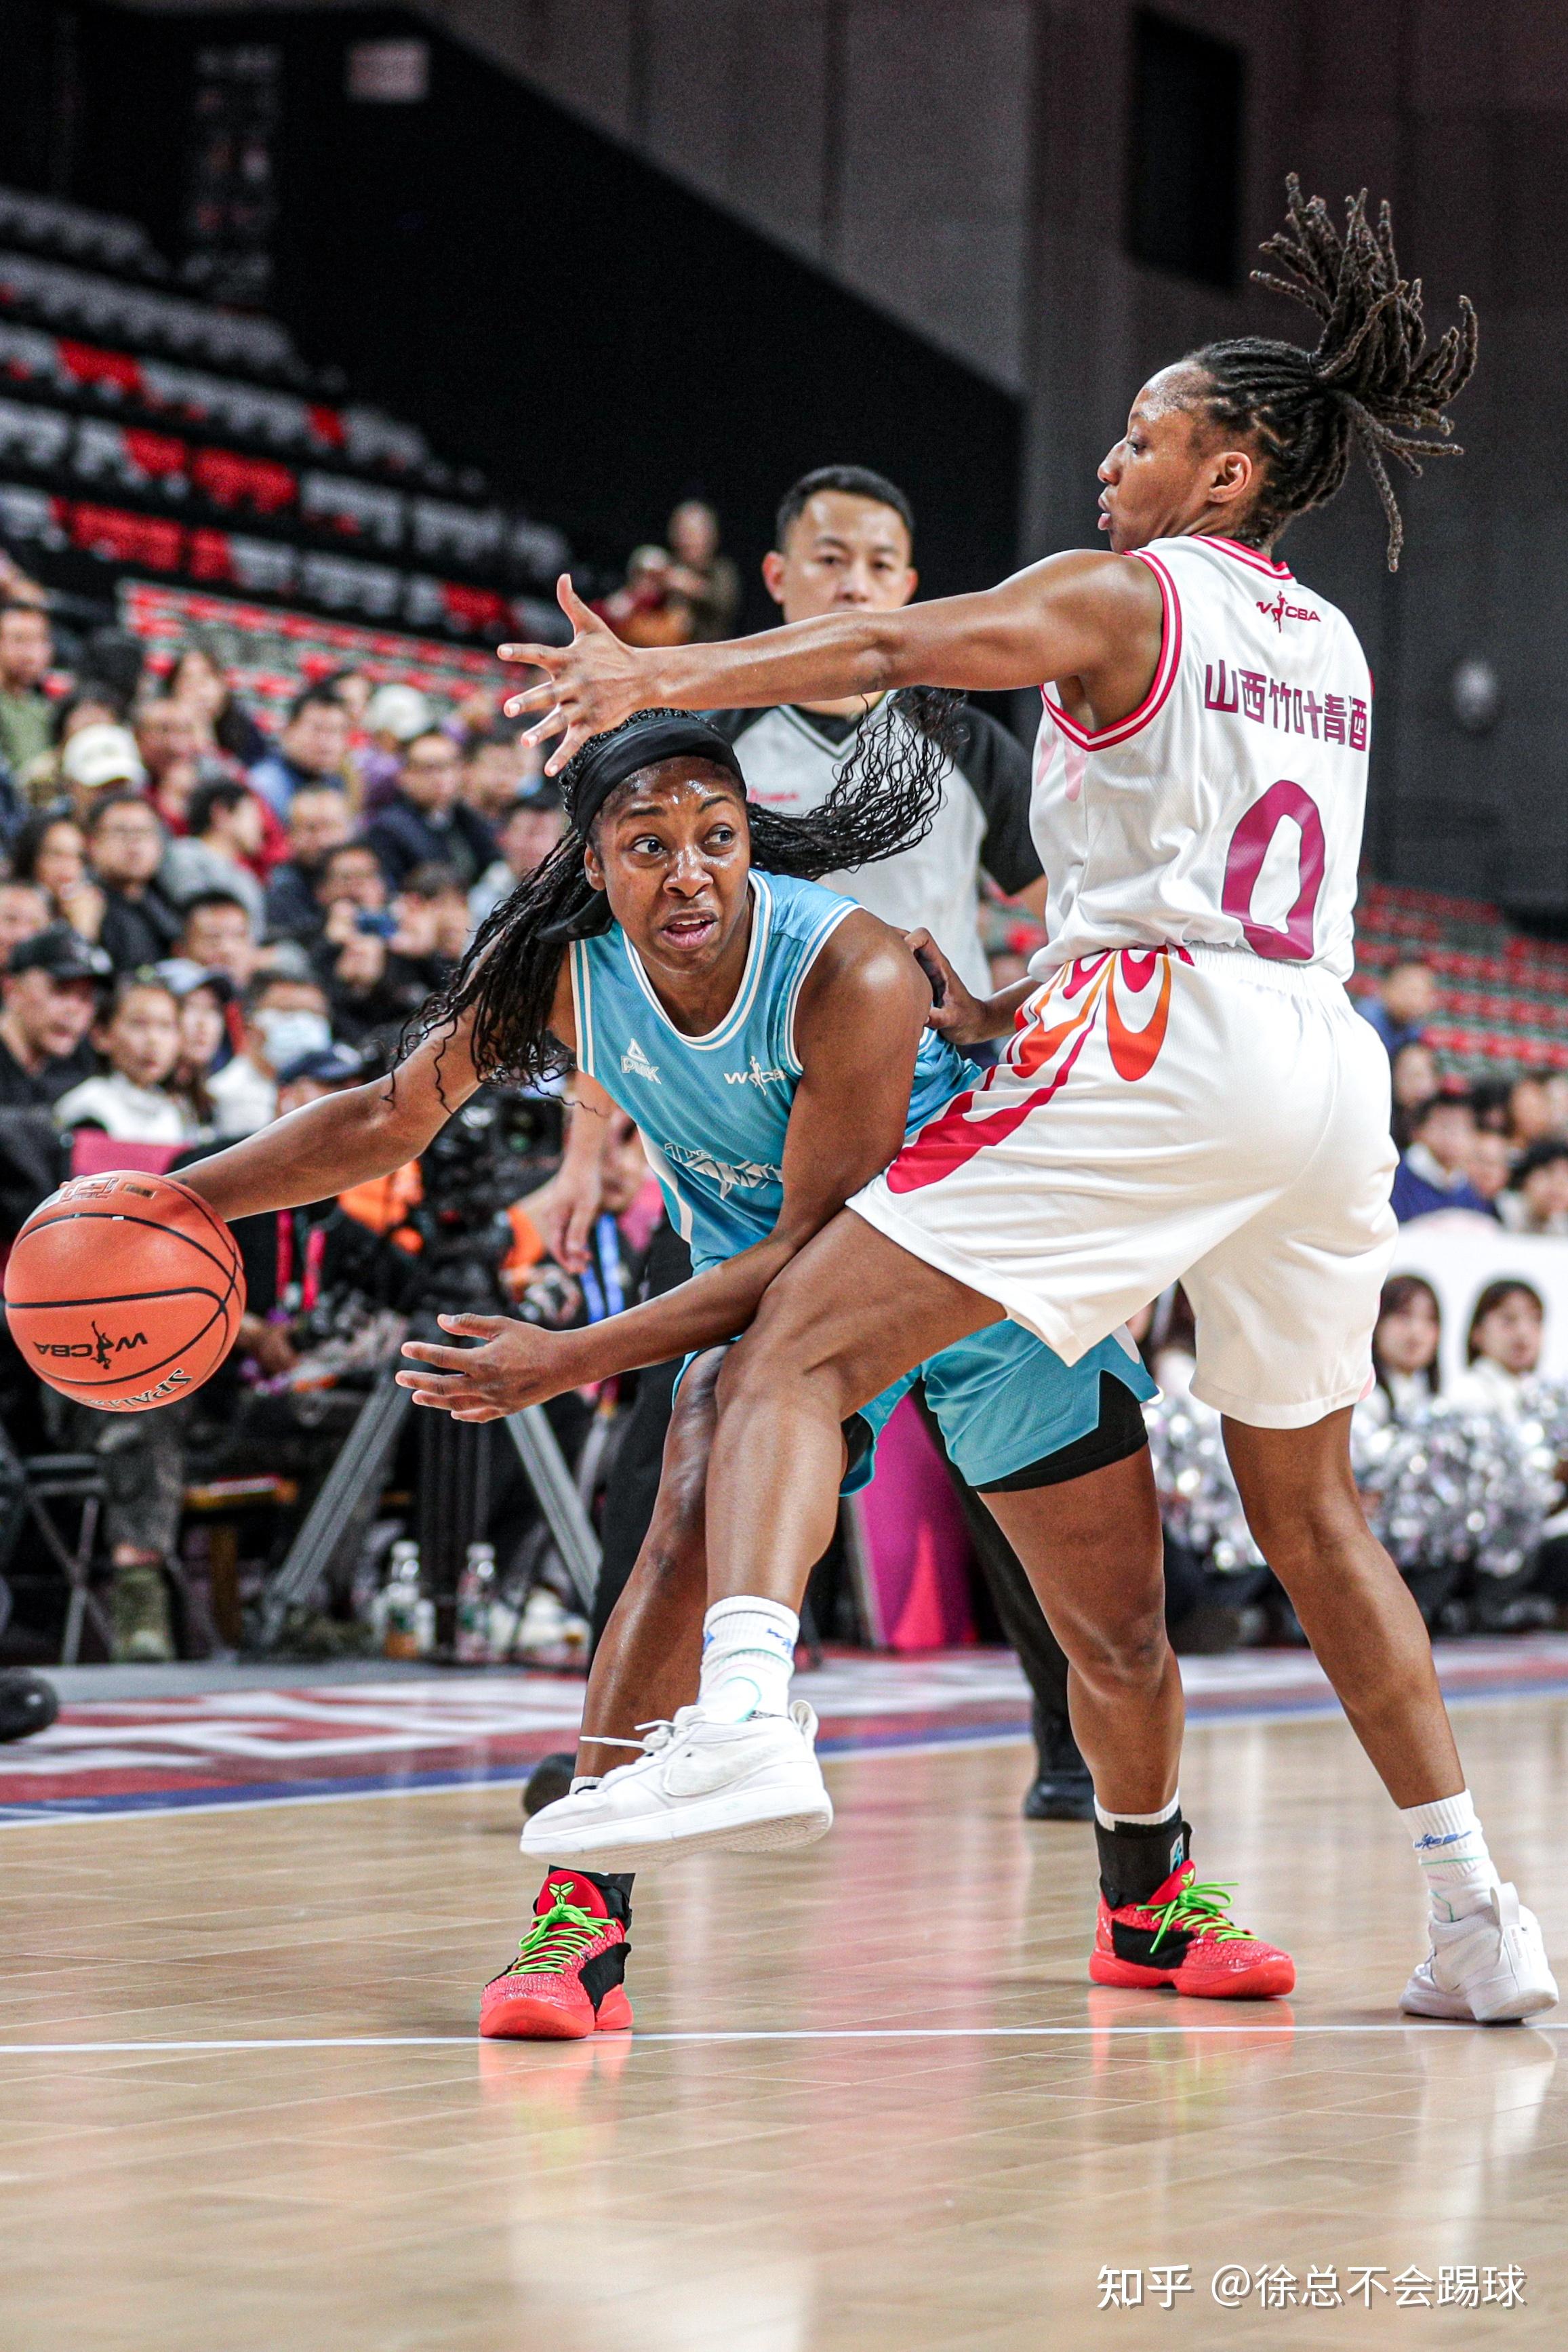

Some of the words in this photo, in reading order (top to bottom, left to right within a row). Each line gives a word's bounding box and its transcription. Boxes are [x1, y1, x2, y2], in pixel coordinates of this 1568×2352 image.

[1205, 659, 1367, 752] 山西竹叶青酒
[1222, 779, 1325, 960] 0
